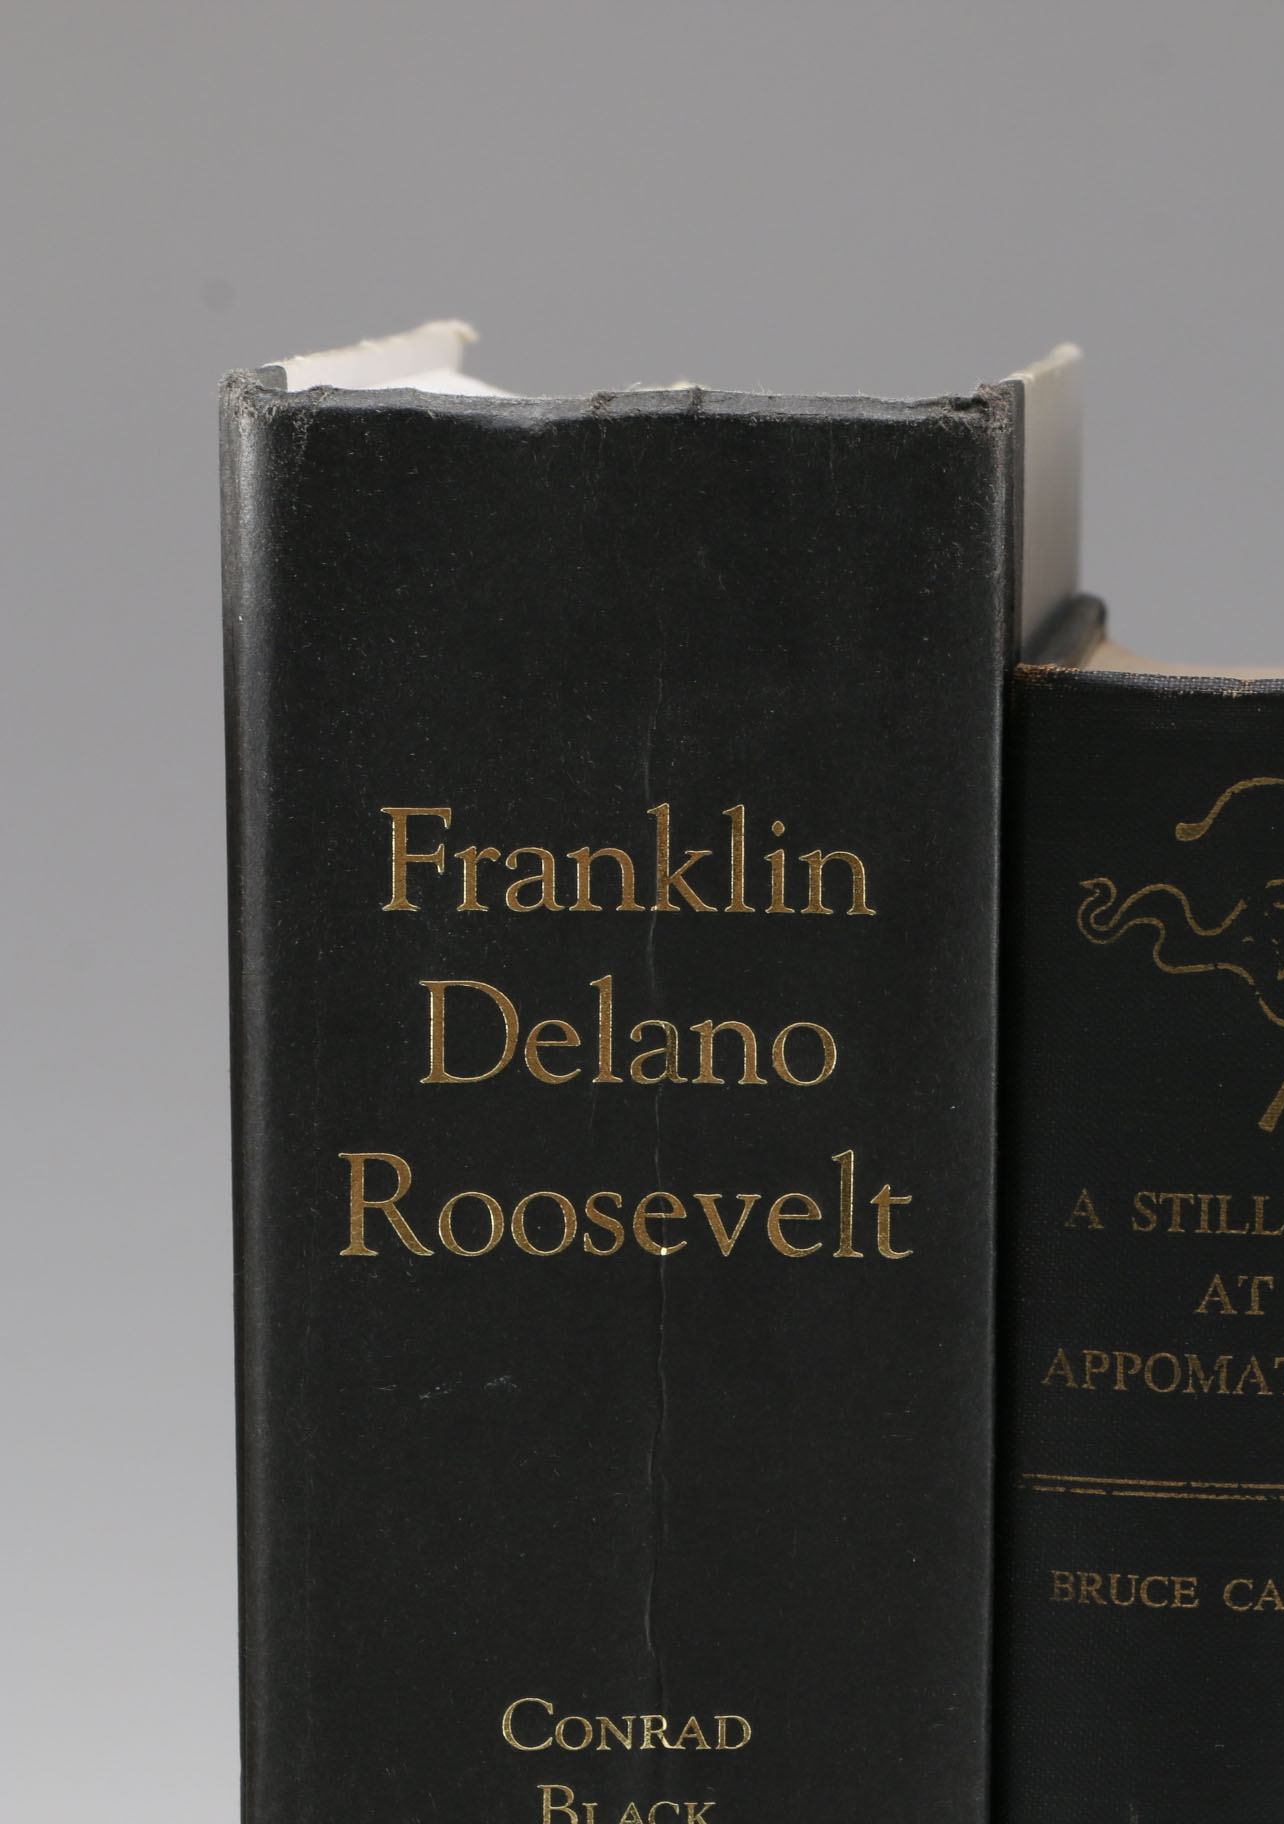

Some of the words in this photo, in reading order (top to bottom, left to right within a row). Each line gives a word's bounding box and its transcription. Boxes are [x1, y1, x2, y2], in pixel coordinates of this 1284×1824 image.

[380, 802, 876, 916] Franklin
[418, 973, 838, 1087] Delano
[338, 1150, 913, 1259] Roosevelt
[1064, 1187, 1105, 1230] A
[1194, 1273, 1275, 1316] AT
[1050, 1569, 1200, 1608] BRUCE
